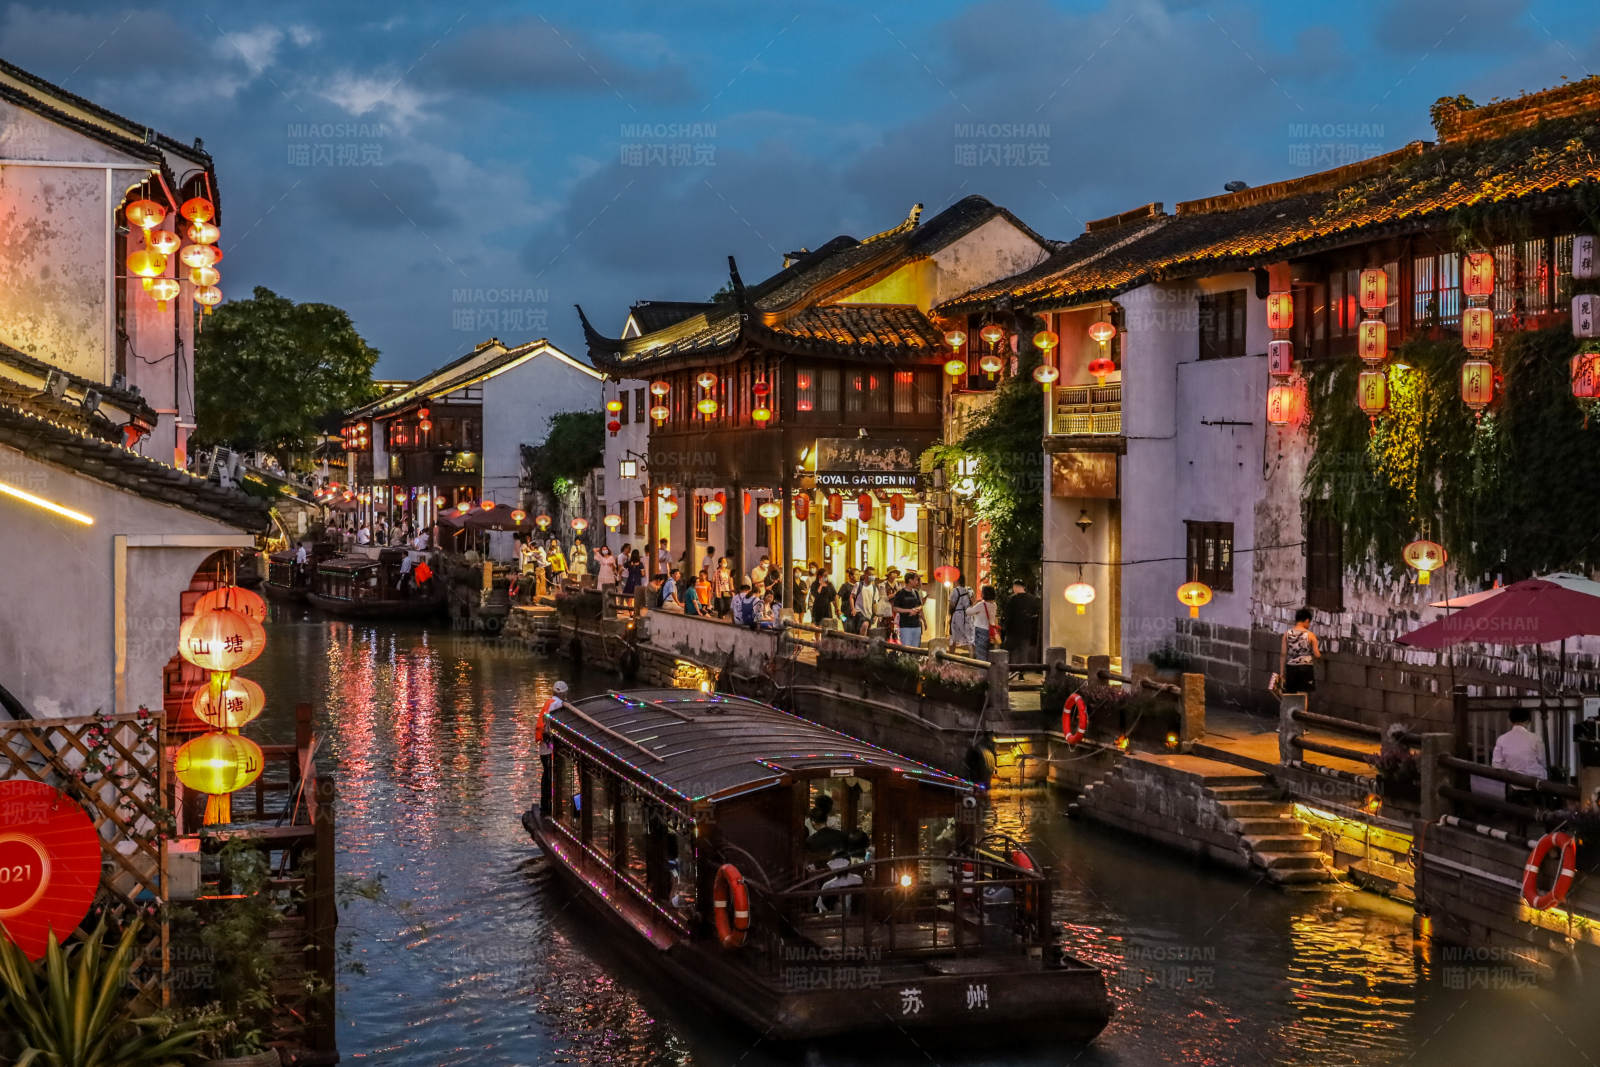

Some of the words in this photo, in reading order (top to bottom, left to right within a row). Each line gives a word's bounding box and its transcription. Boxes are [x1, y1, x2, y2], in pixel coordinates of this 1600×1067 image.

[816, 475, 848, 485] ROYAL
[852, 475, 896, 485] GARDEN
[898, 475, 916, 485] INN
[194, 634, 244, 655] 山塘
[204, 697, 244, 717] 山塘
[245, 756, 257, 774] 山
[899, 983, 989, 1015] 苏州
